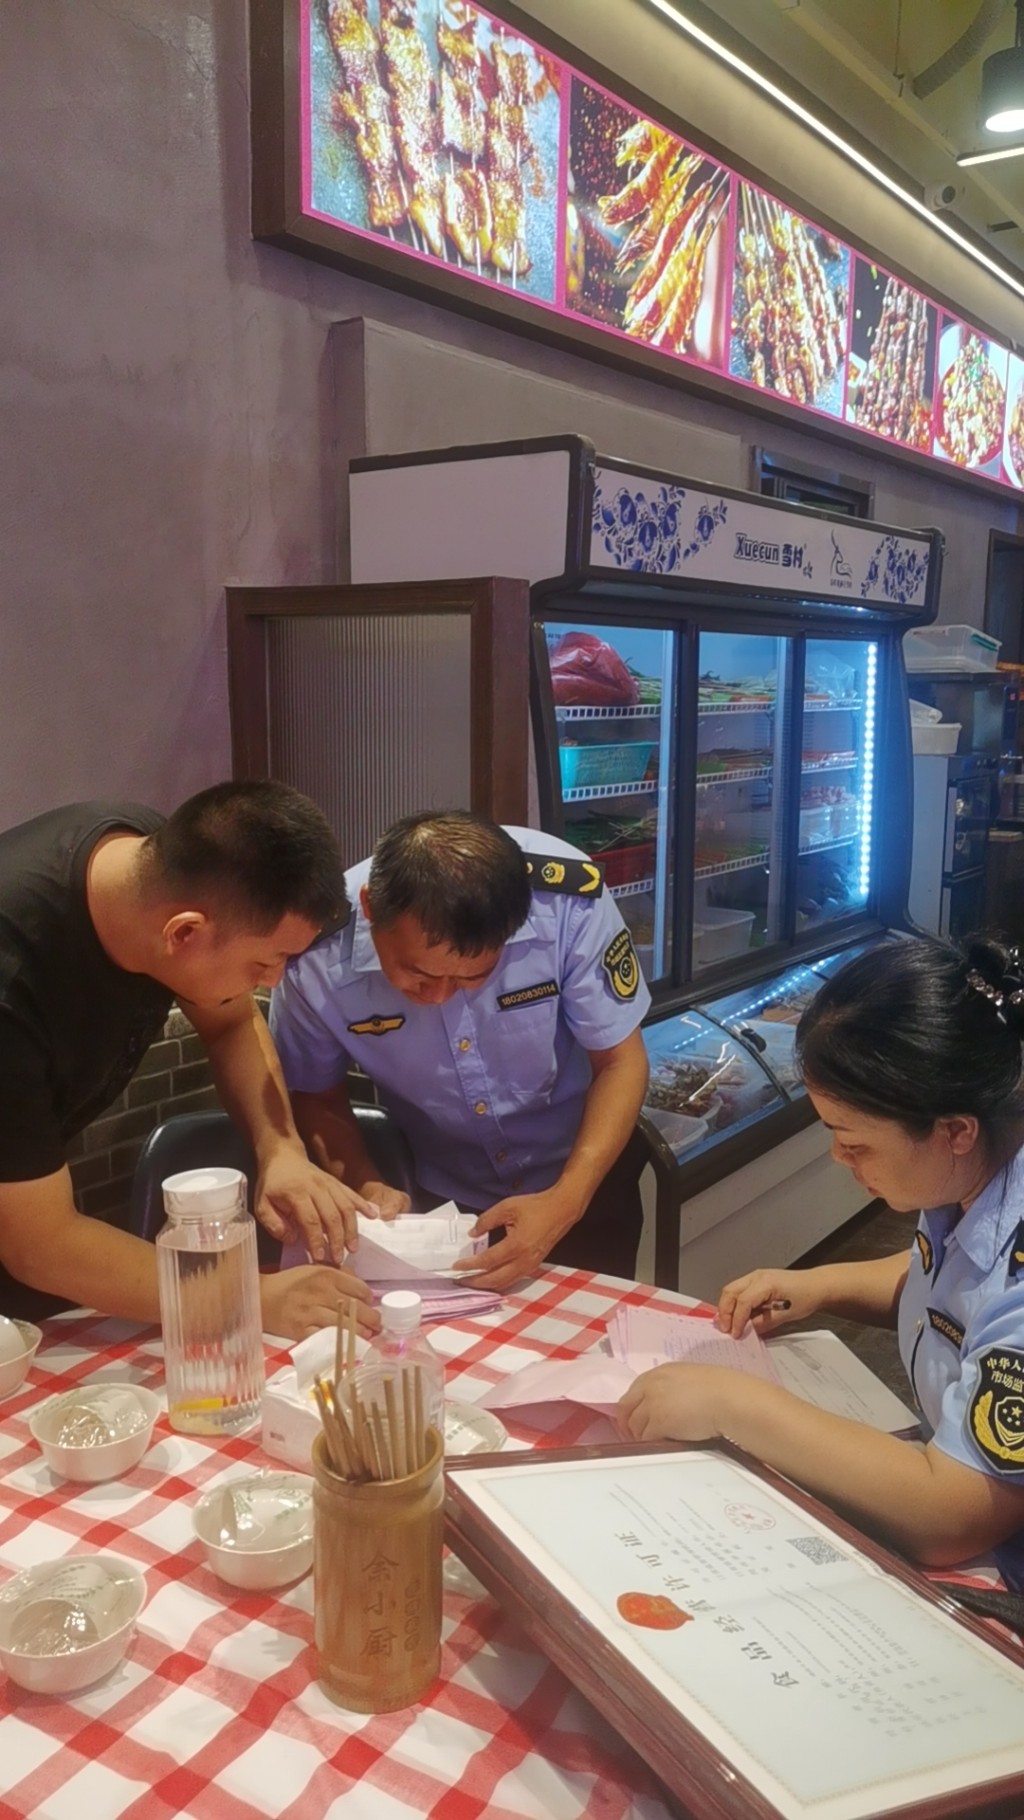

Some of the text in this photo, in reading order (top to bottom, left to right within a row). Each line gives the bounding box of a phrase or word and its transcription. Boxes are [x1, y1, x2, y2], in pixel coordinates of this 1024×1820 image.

[735, 535, 779, 563] Xuecun
[501, 983, 556, 1006] 18020830114
[987, 1355, 1024, 1373] 中华人
